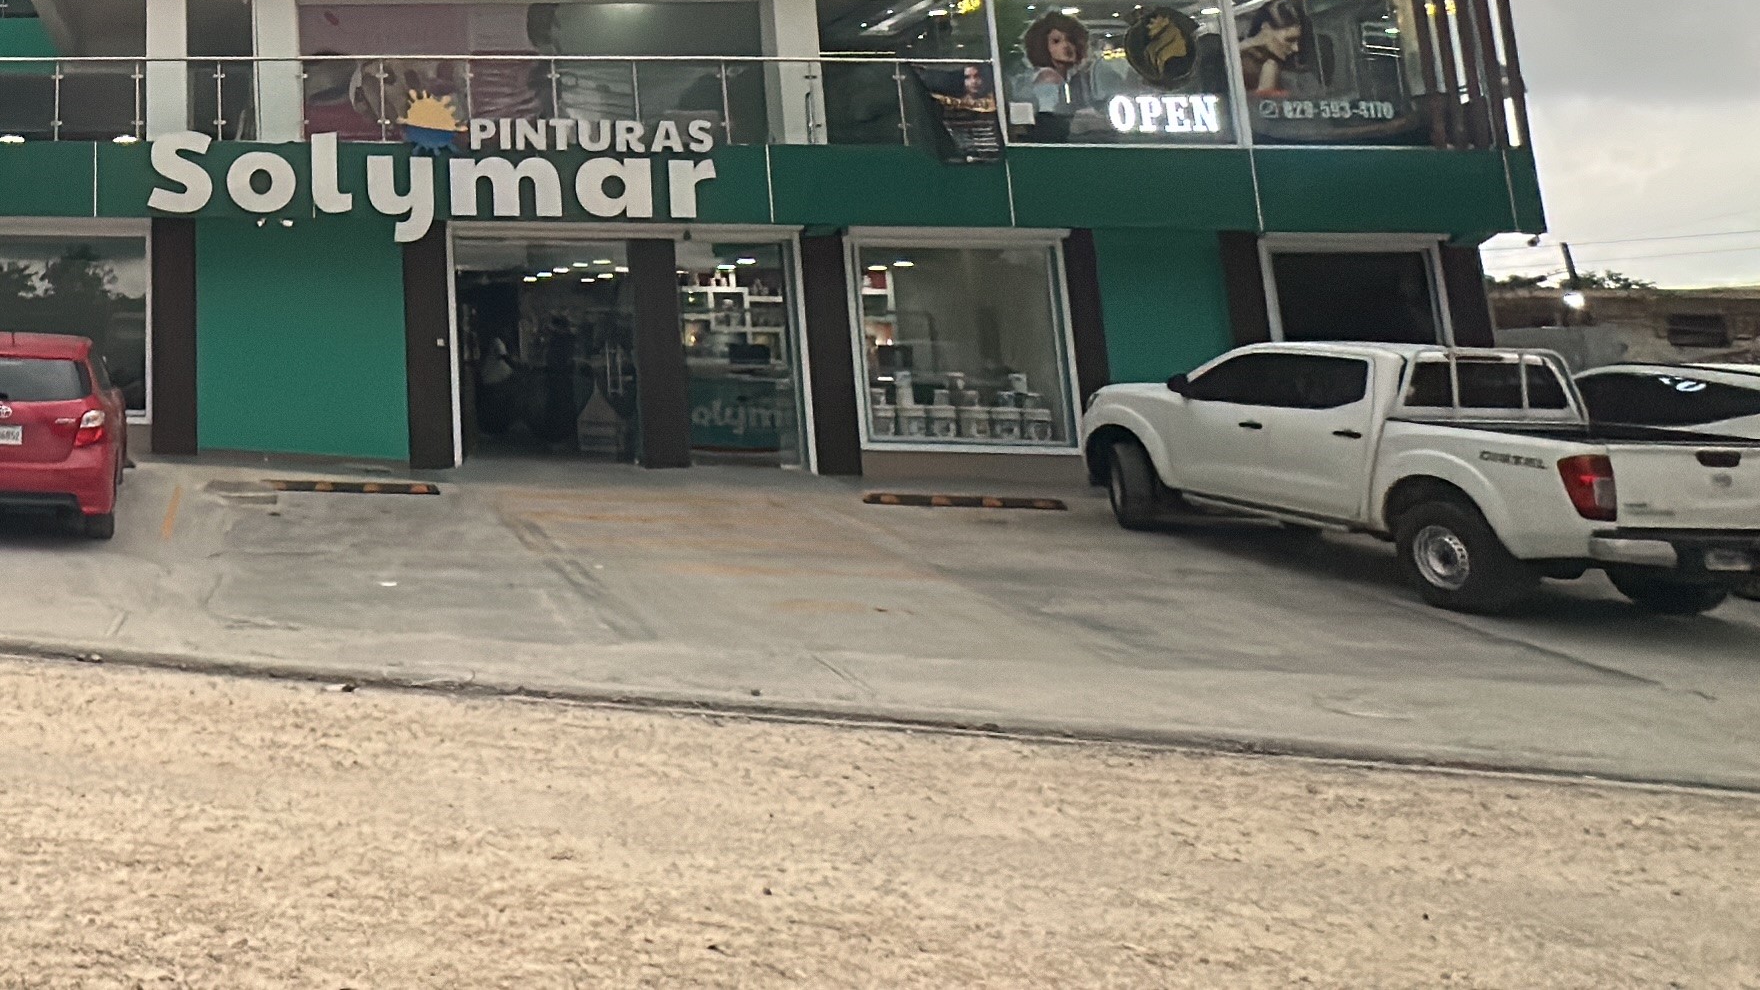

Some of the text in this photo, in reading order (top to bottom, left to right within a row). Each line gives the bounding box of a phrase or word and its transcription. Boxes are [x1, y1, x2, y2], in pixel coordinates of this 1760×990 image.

[1108, 94, 1219, 133] OPEN
[469, 118, 715, 153] PINTURAS
[147, 130, 716, 243] Solymar
